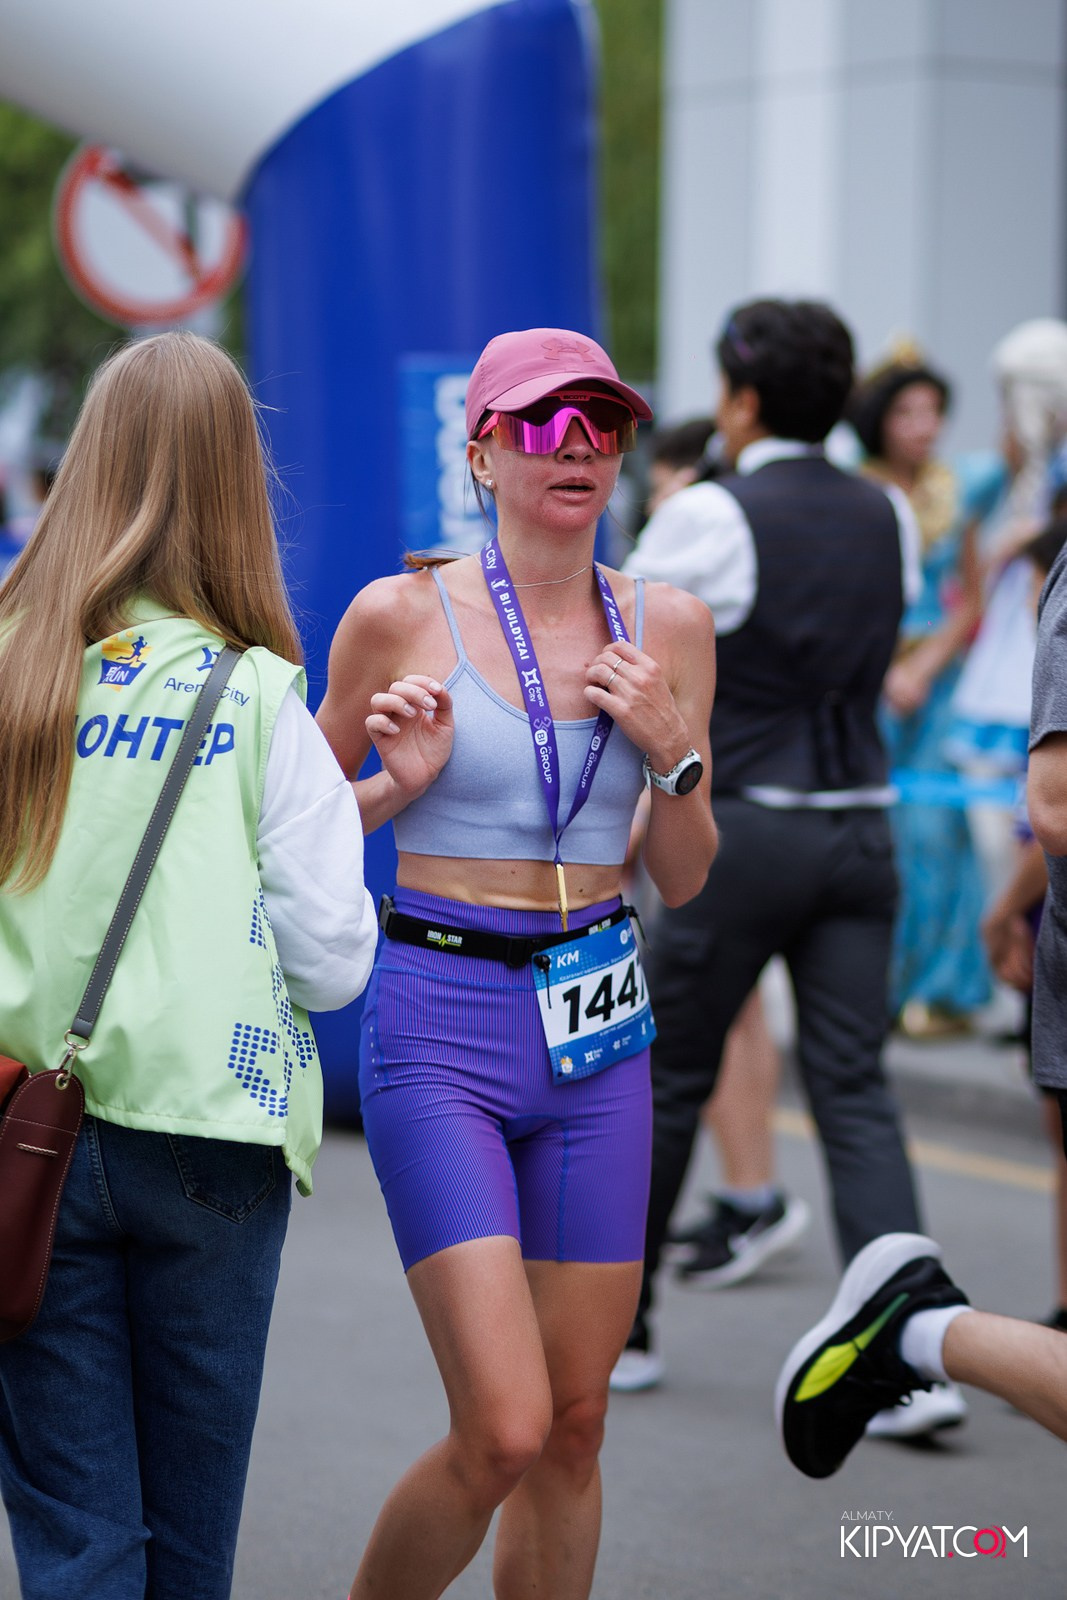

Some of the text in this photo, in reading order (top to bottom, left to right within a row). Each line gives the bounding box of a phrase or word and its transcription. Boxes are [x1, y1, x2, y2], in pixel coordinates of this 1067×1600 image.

[485, 549, 498, 570] City
[499, 592, 530, 661] BI JULDYZAI
[163, 677, 205, 693] Aren
[534, 686, 545, 707] Arena
[74, 713, 235, 766] ОНТР
[540, 746, 553, 784] GROUP
[581, 751, 596, 789] GROUP
[446, 934, 463, 945] STAR
[557, 950, 580, 969] KM
[562, 956, 645, 1035] 144
